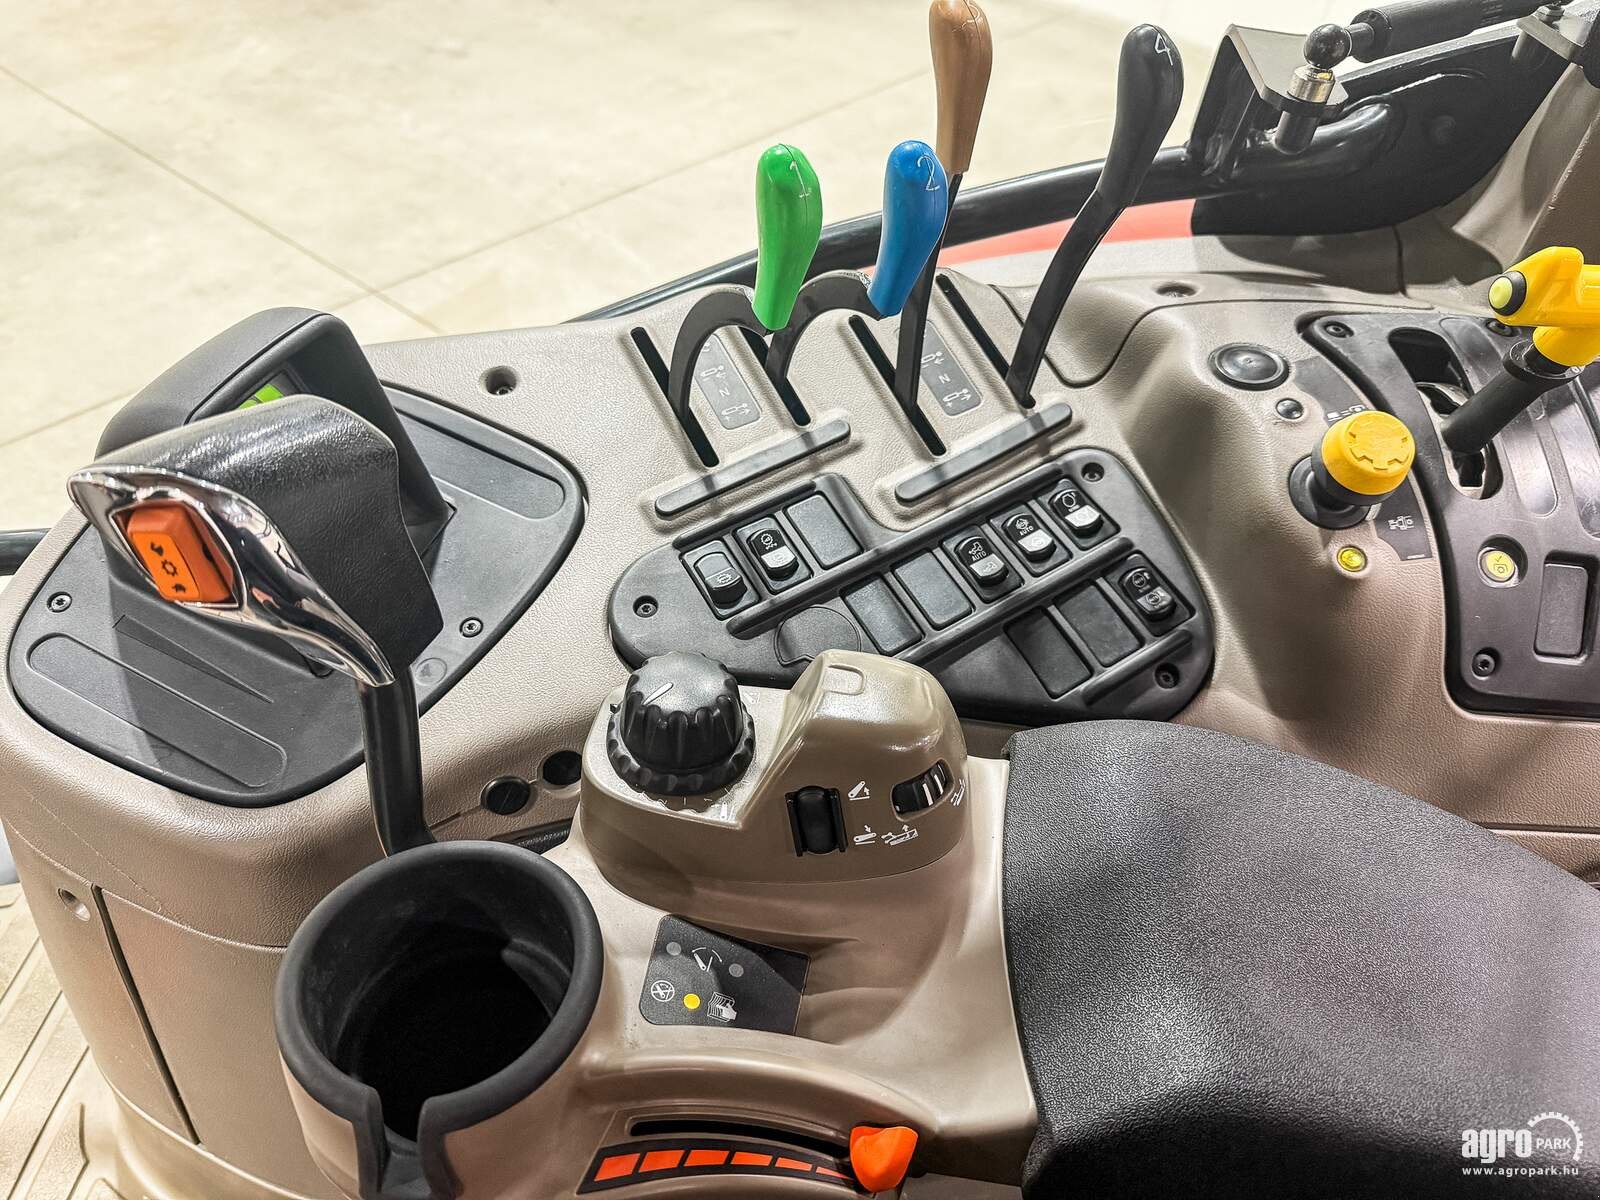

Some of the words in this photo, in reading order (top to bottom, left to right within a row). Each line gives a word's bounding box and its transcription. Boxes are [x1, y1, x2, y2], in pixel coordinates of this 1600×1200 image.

[1155, 33, 1174, 65] 4
[790, 161, 809, 199] 1
[917, 156, 939, 191] 2
[938, 374, 951, 384] N
[1019, 525, 1034, 536] AUTO
[971, 550, 987, 562] AUTO
